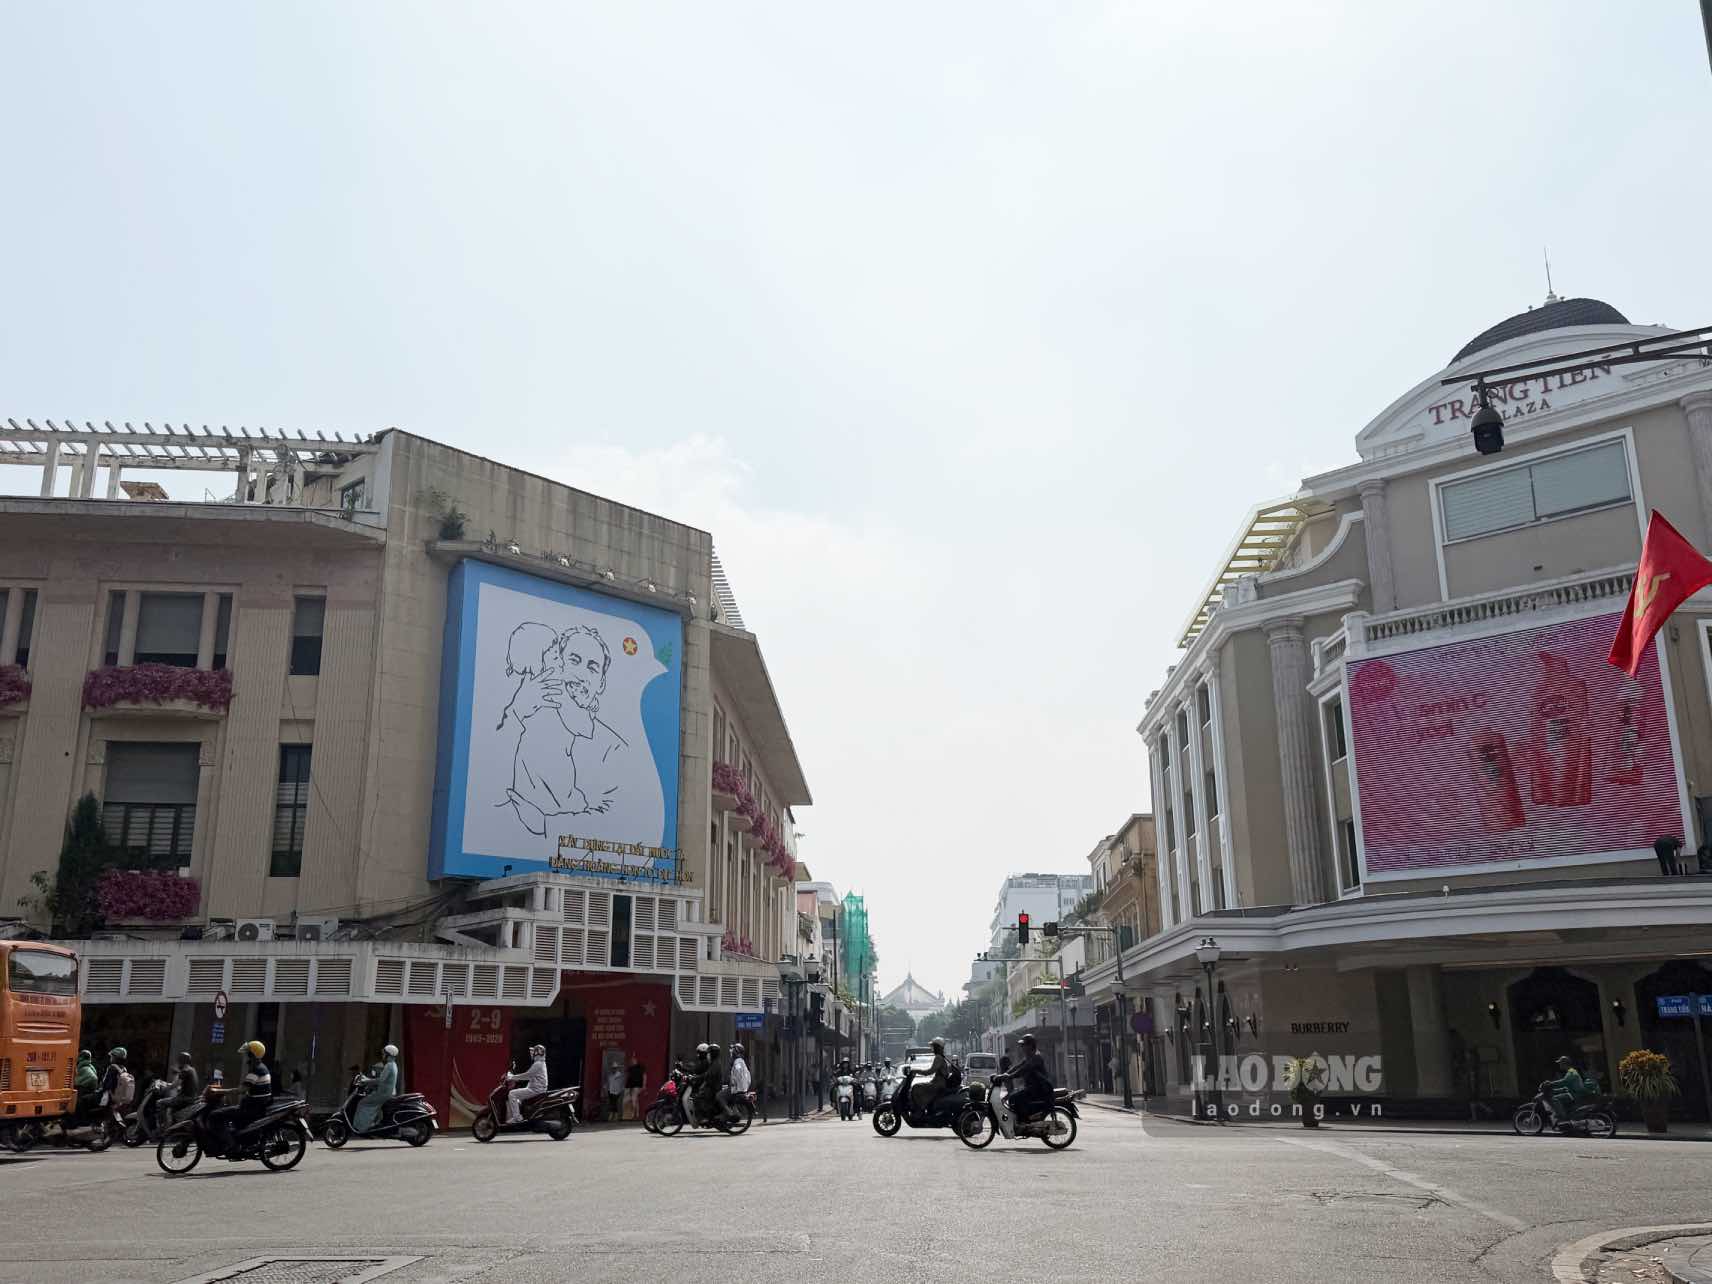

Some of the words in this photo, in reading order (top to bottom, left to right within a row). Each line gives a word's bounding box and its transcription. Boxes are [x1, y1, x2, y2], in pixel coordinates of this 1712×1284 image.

[1501, 398, 1552, 420] LAZA
[470, 1008, 502, 1029] 2-9
[1291, 1022, 1349, 1034] BURBERRY
